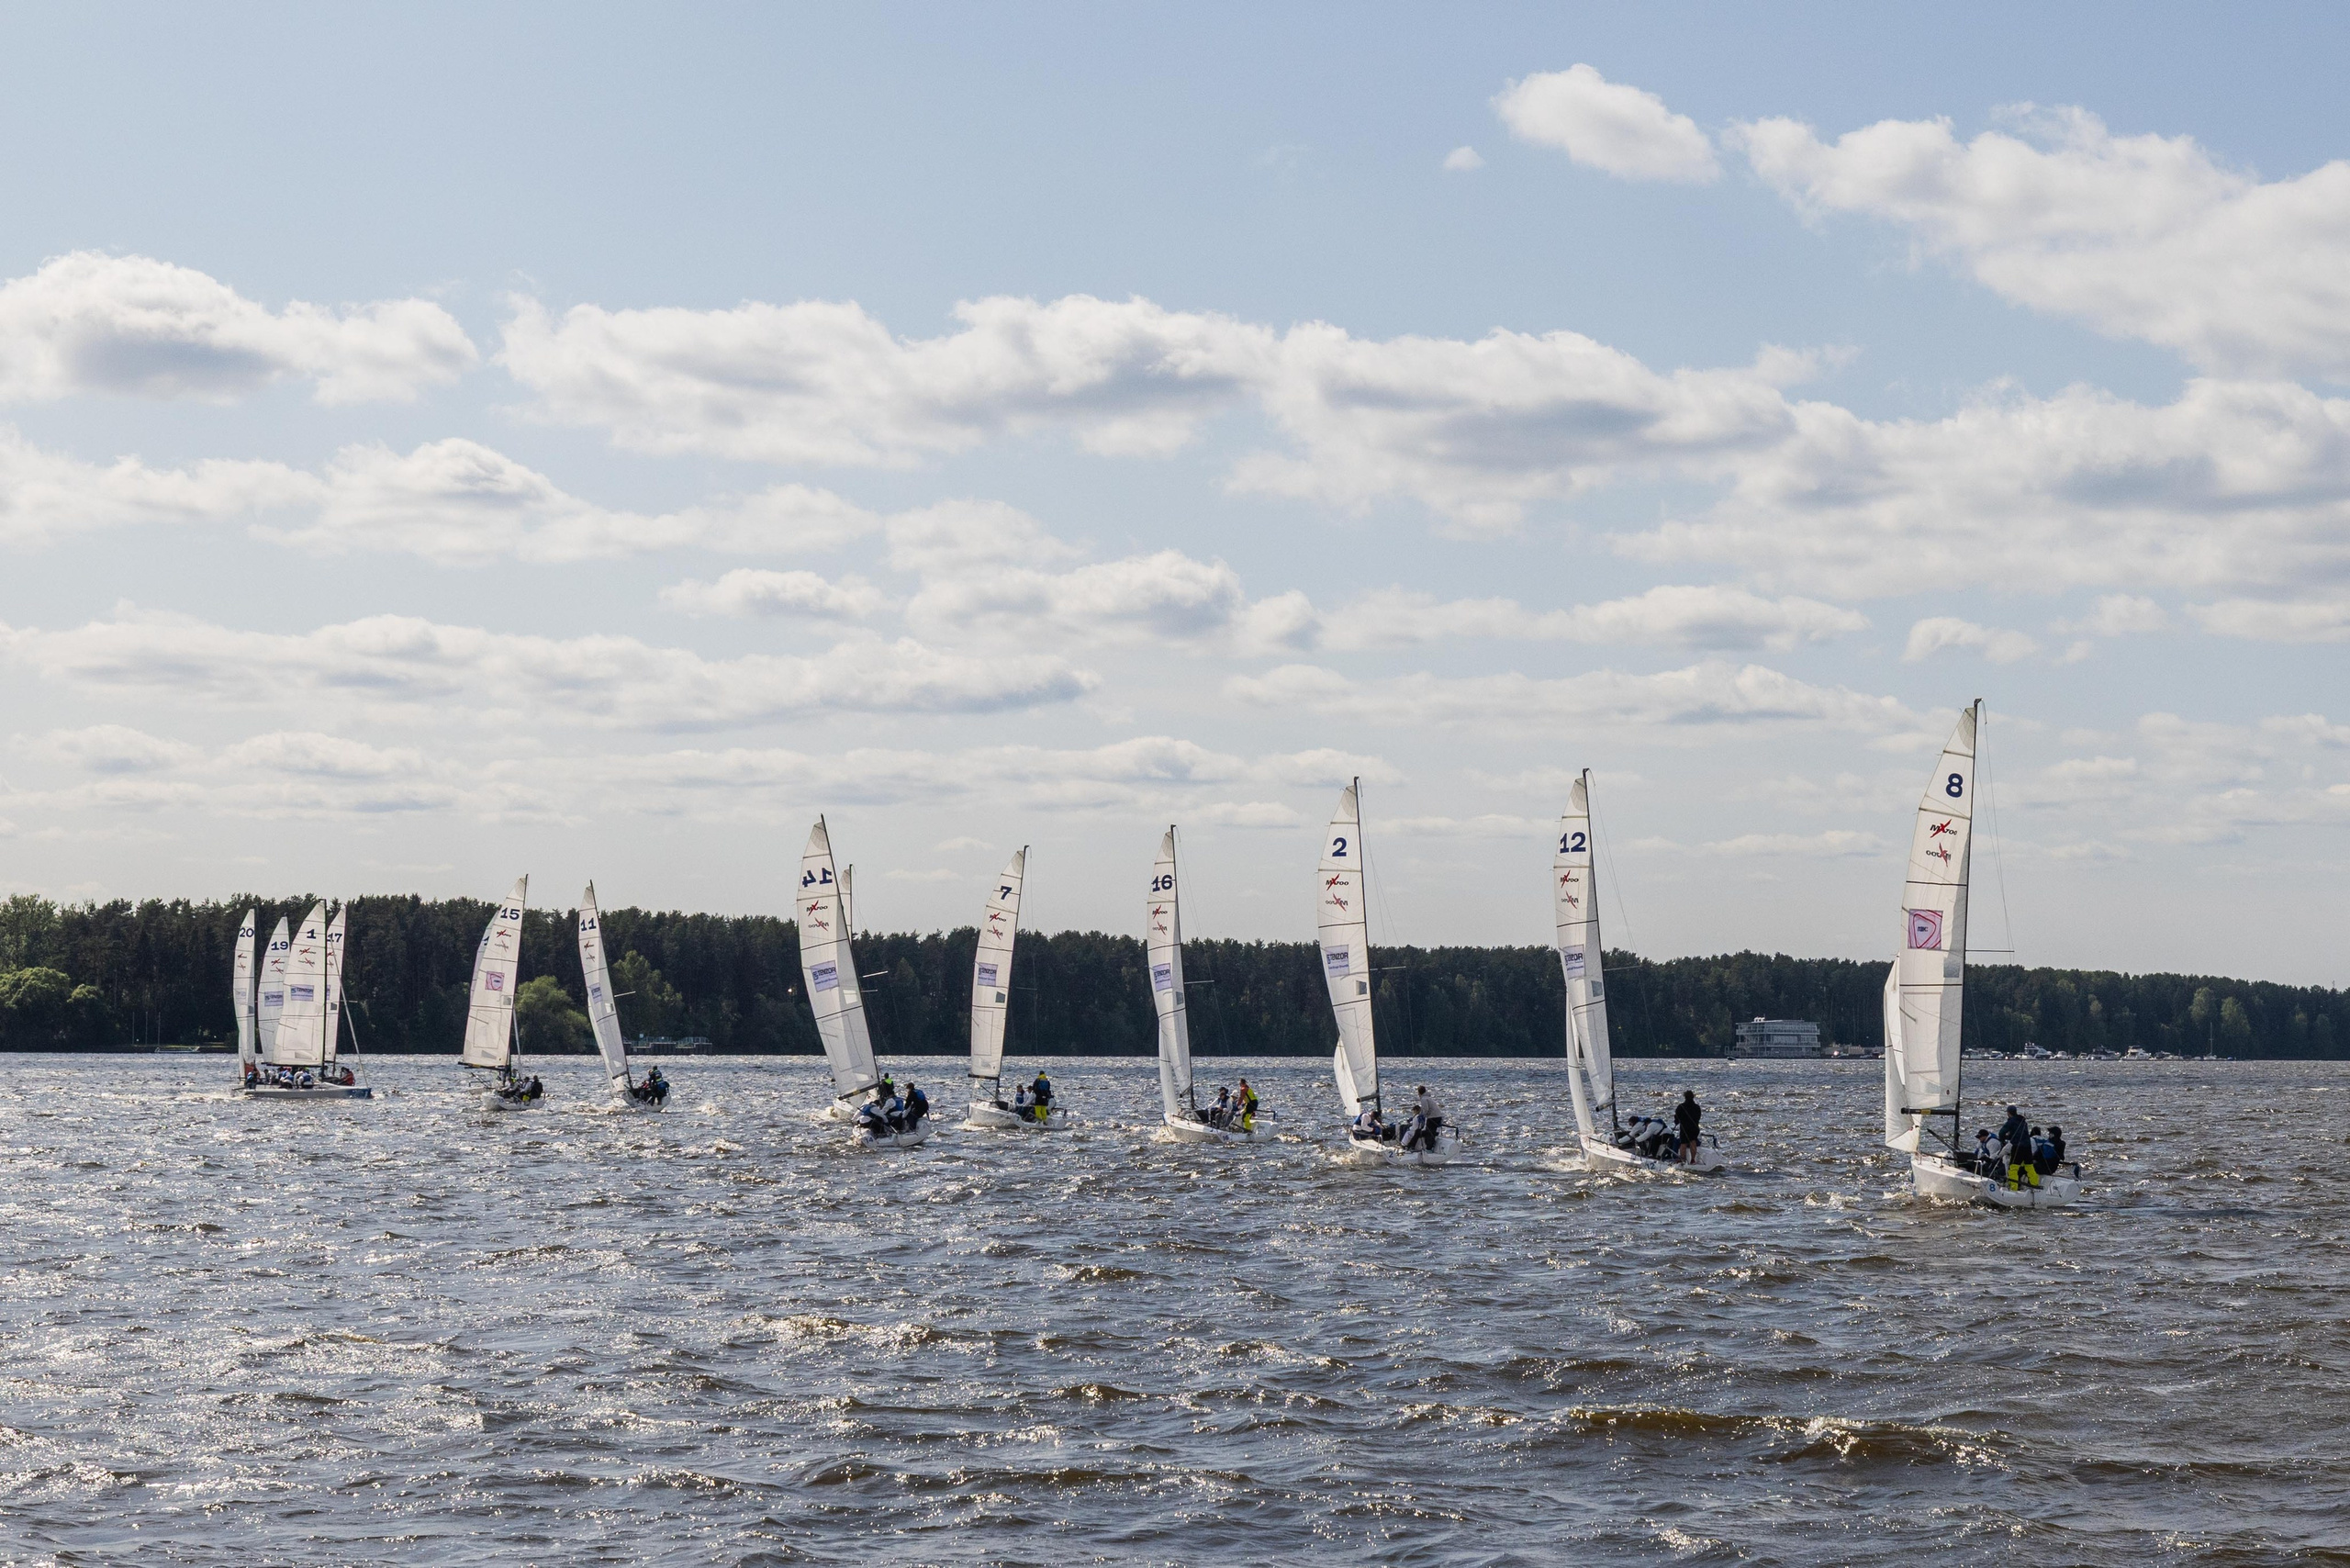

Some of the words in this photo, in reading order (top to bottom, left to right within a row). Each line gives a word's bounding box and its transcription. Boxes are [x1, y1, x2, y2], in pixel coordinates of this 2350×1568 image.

[1945, 773, 1964, 798] 8
[1332, 837, 1348, 857] 2
[1560, 832, 1586, 854] 12
[1151, 874, 1173, 892] 16
[1001, 885, 1013, 901] 7
[500, 907, 520, 921] 15
[580, 917, 596, 932] 11
[240, 927, 254, 937] 20
[307, 928, 317, 939] 1
[327, 933, 342, 943] 17
[271, 941, 288, 950] 19
[1989, 1183, 1997, 1192] 8
